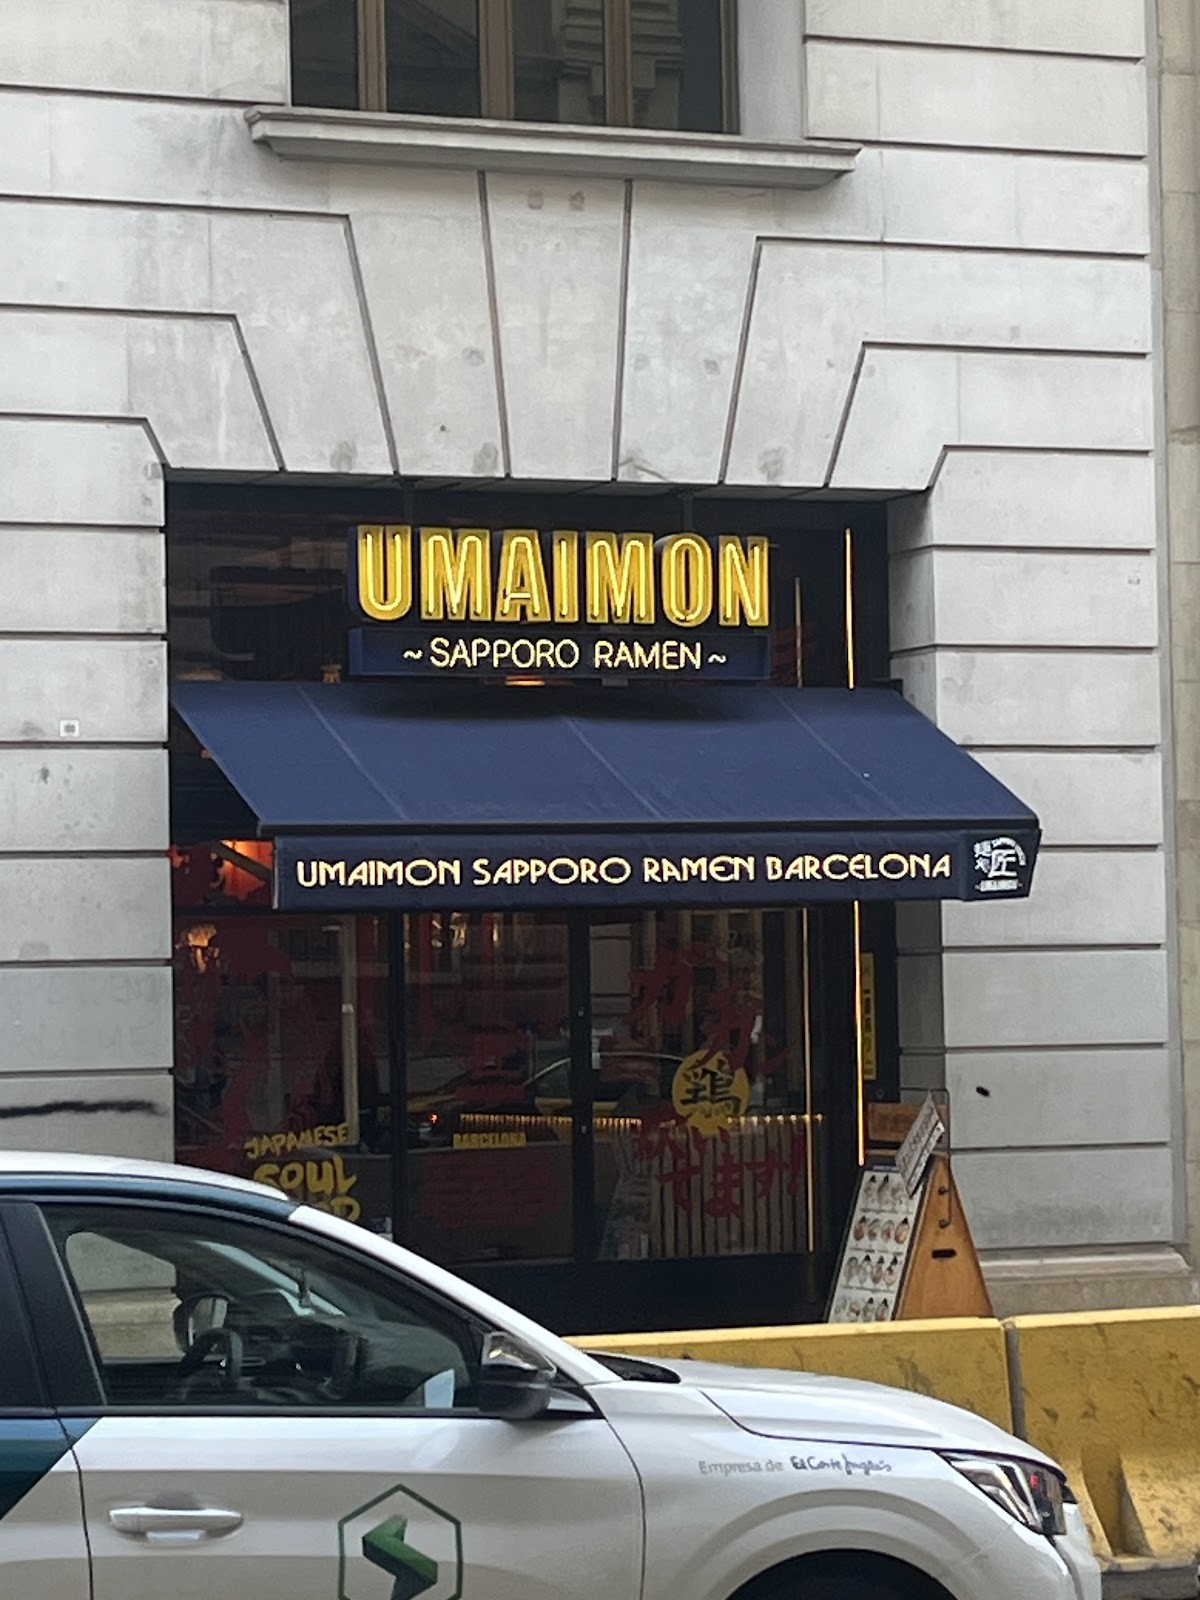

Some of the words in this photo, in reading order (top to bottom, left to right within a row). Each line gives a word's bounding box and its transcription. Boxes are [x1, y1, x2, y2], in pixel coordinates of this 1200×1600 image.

[357, 525, 769, 627] UMAIMON
[296, 857, 461, 888] UMAIMON
[472, 857, 632, 886] SAPPORO
[642, 855, 755, 883] RAMEN
[765, 853, 952, 880] BARCELONA
[244, 1122, 350, 1160] JAPANESE
[698, 1459, 762, 1476] Empresa
[767, 1458, 785, 1473] de
